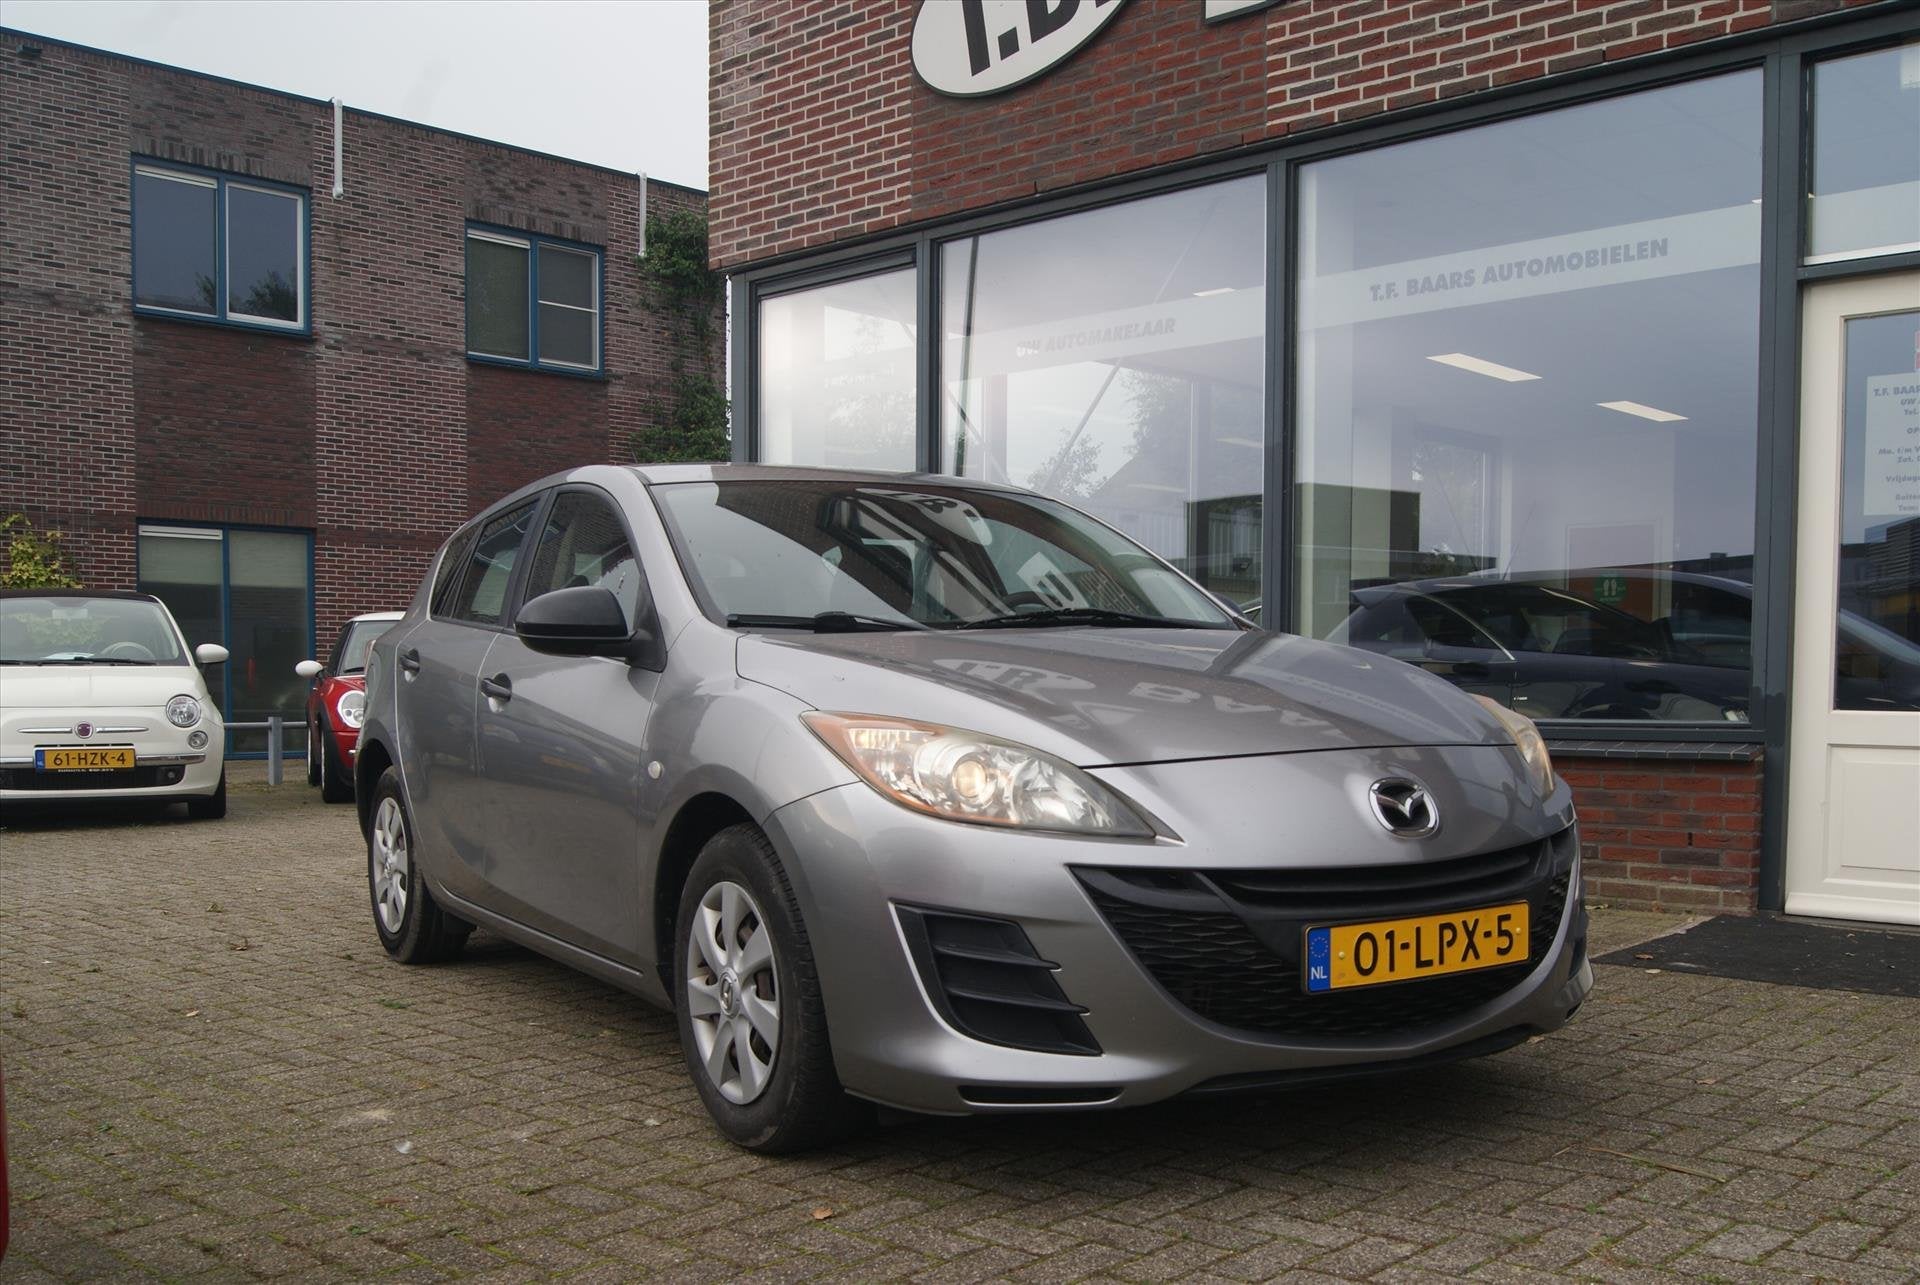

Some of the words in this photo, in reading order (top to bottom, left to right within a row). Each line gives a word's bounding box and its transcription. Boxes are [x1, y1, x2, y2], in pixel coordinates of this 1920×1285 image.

[1369, 282, 1399, 302] T.F.
[1406, 268, 1476, 296] BAARS
[1481, 237, 1669, 285] AUTOMOBIELEN
[1045, 317, 1177, 352] AUTOMAKELAAR
[53, 752, 126, 766] 61-HZK-4
[1311, 966, 1328, 980] NL
[1353, 914, 1514, 977] 01-LPX-5
